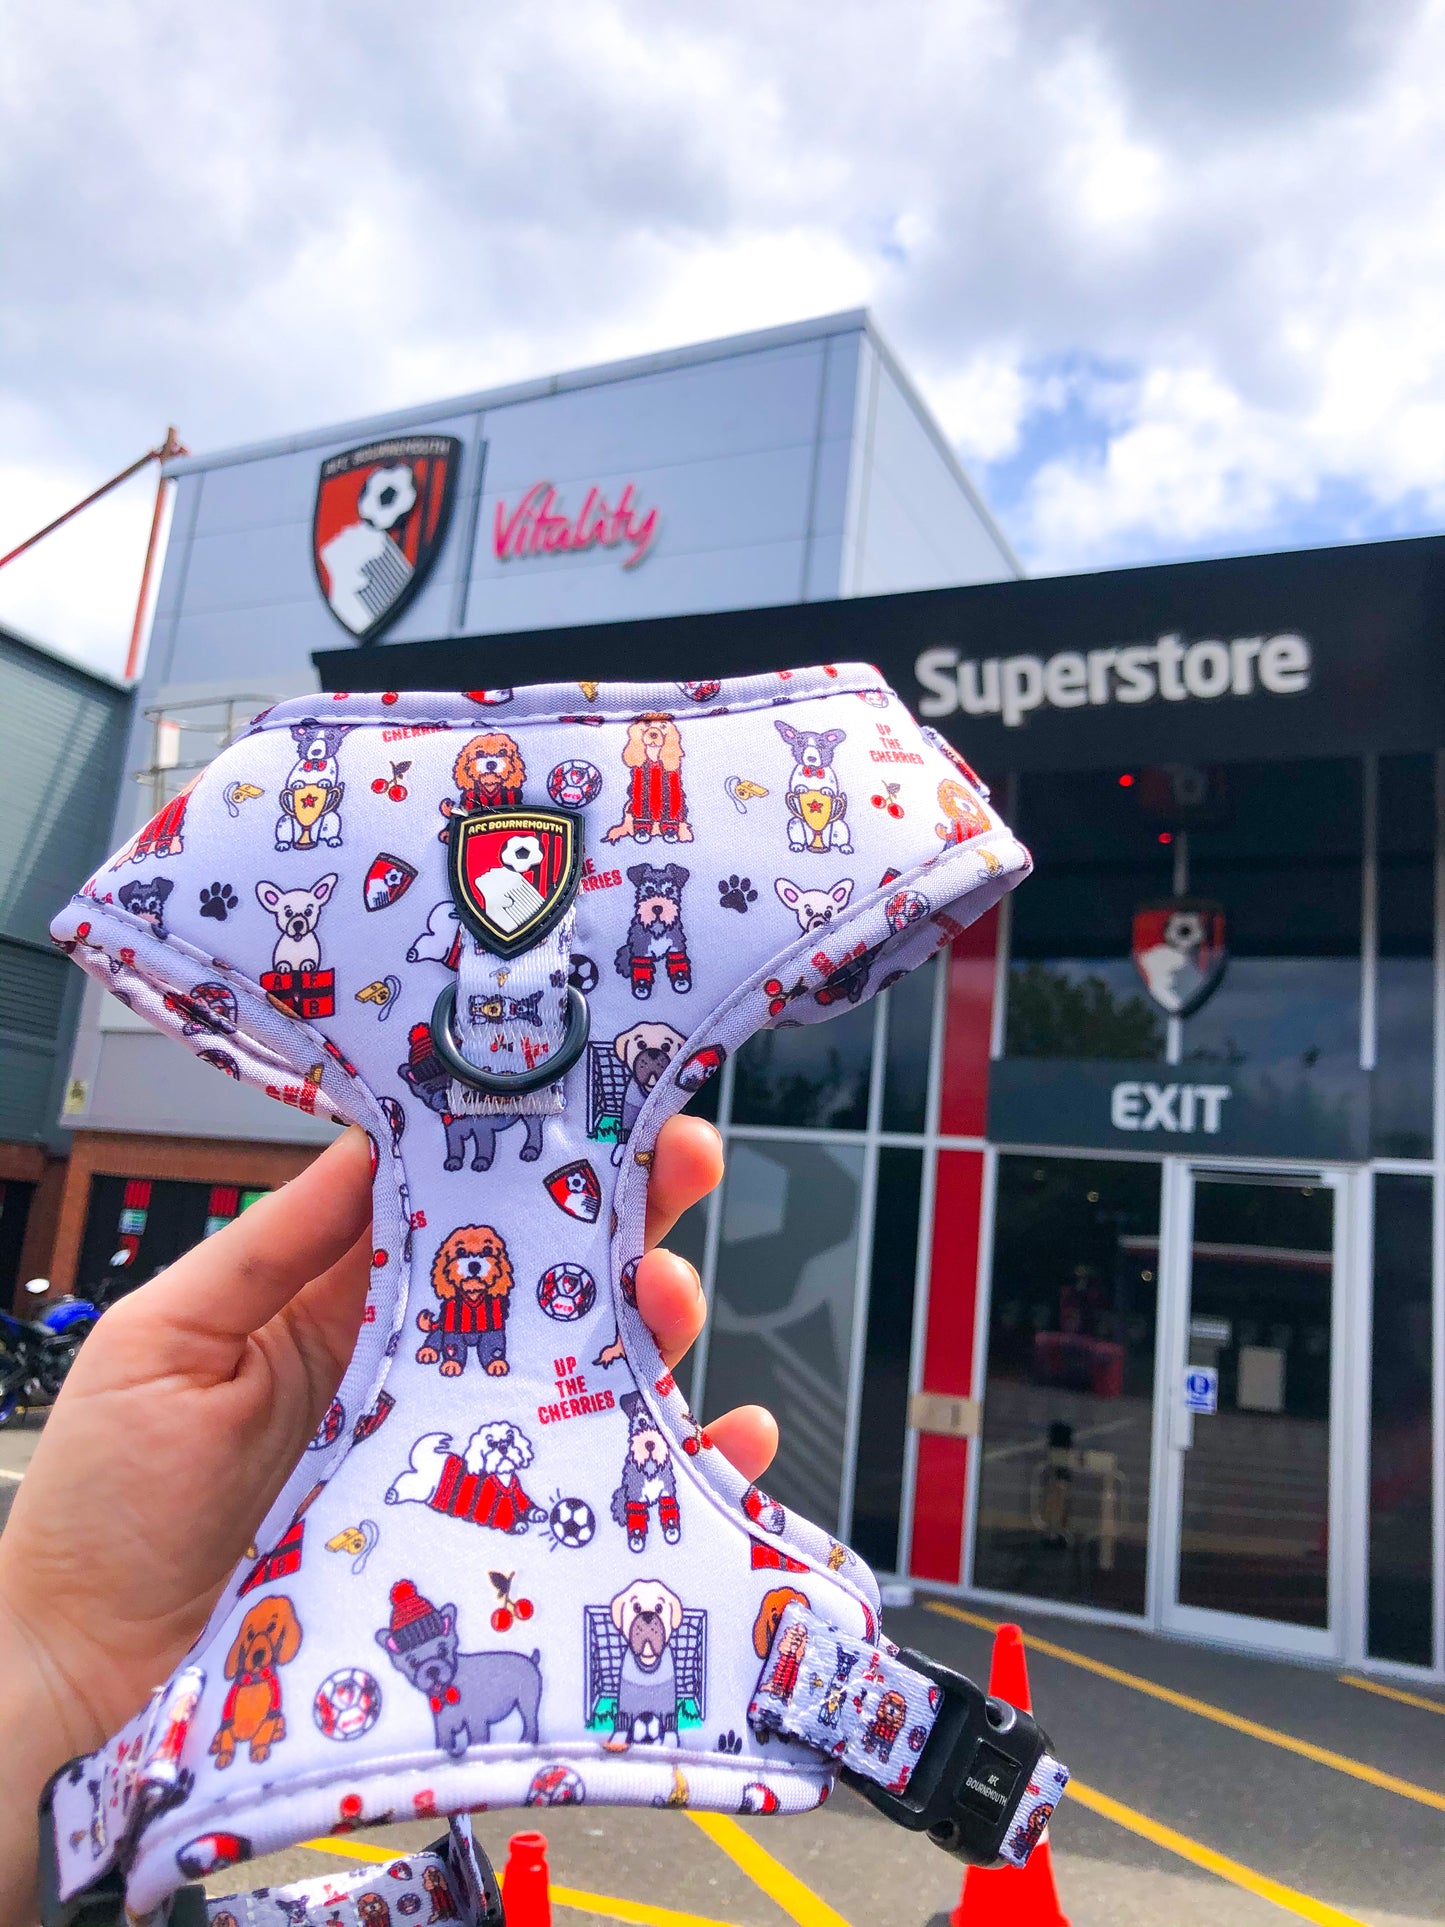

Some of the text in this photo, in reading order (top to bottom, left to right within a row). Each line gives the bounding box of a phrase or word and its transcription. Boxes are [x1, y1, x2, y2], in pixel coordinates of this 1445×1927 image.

[494, 481, 658, 570] Vitality
[915, 633, 1310, 727] Superstore
[875, 722, 891, 736] UP
[879, 737, 903, 750] THE
[869, 750, 924, 765] CHERRIES
[468, 819, 563, 834] AFC BOURNEMOUTH
[1111, 1080, 1232, 1134] EXIT
[553, 1356, 577, 1377] UP
[554, 1375, 588, 1398] THE
[537, 1389, 616, 1425] CHERRIES
[965, 1776, 1008, 1806] BOURNEMOUTH
